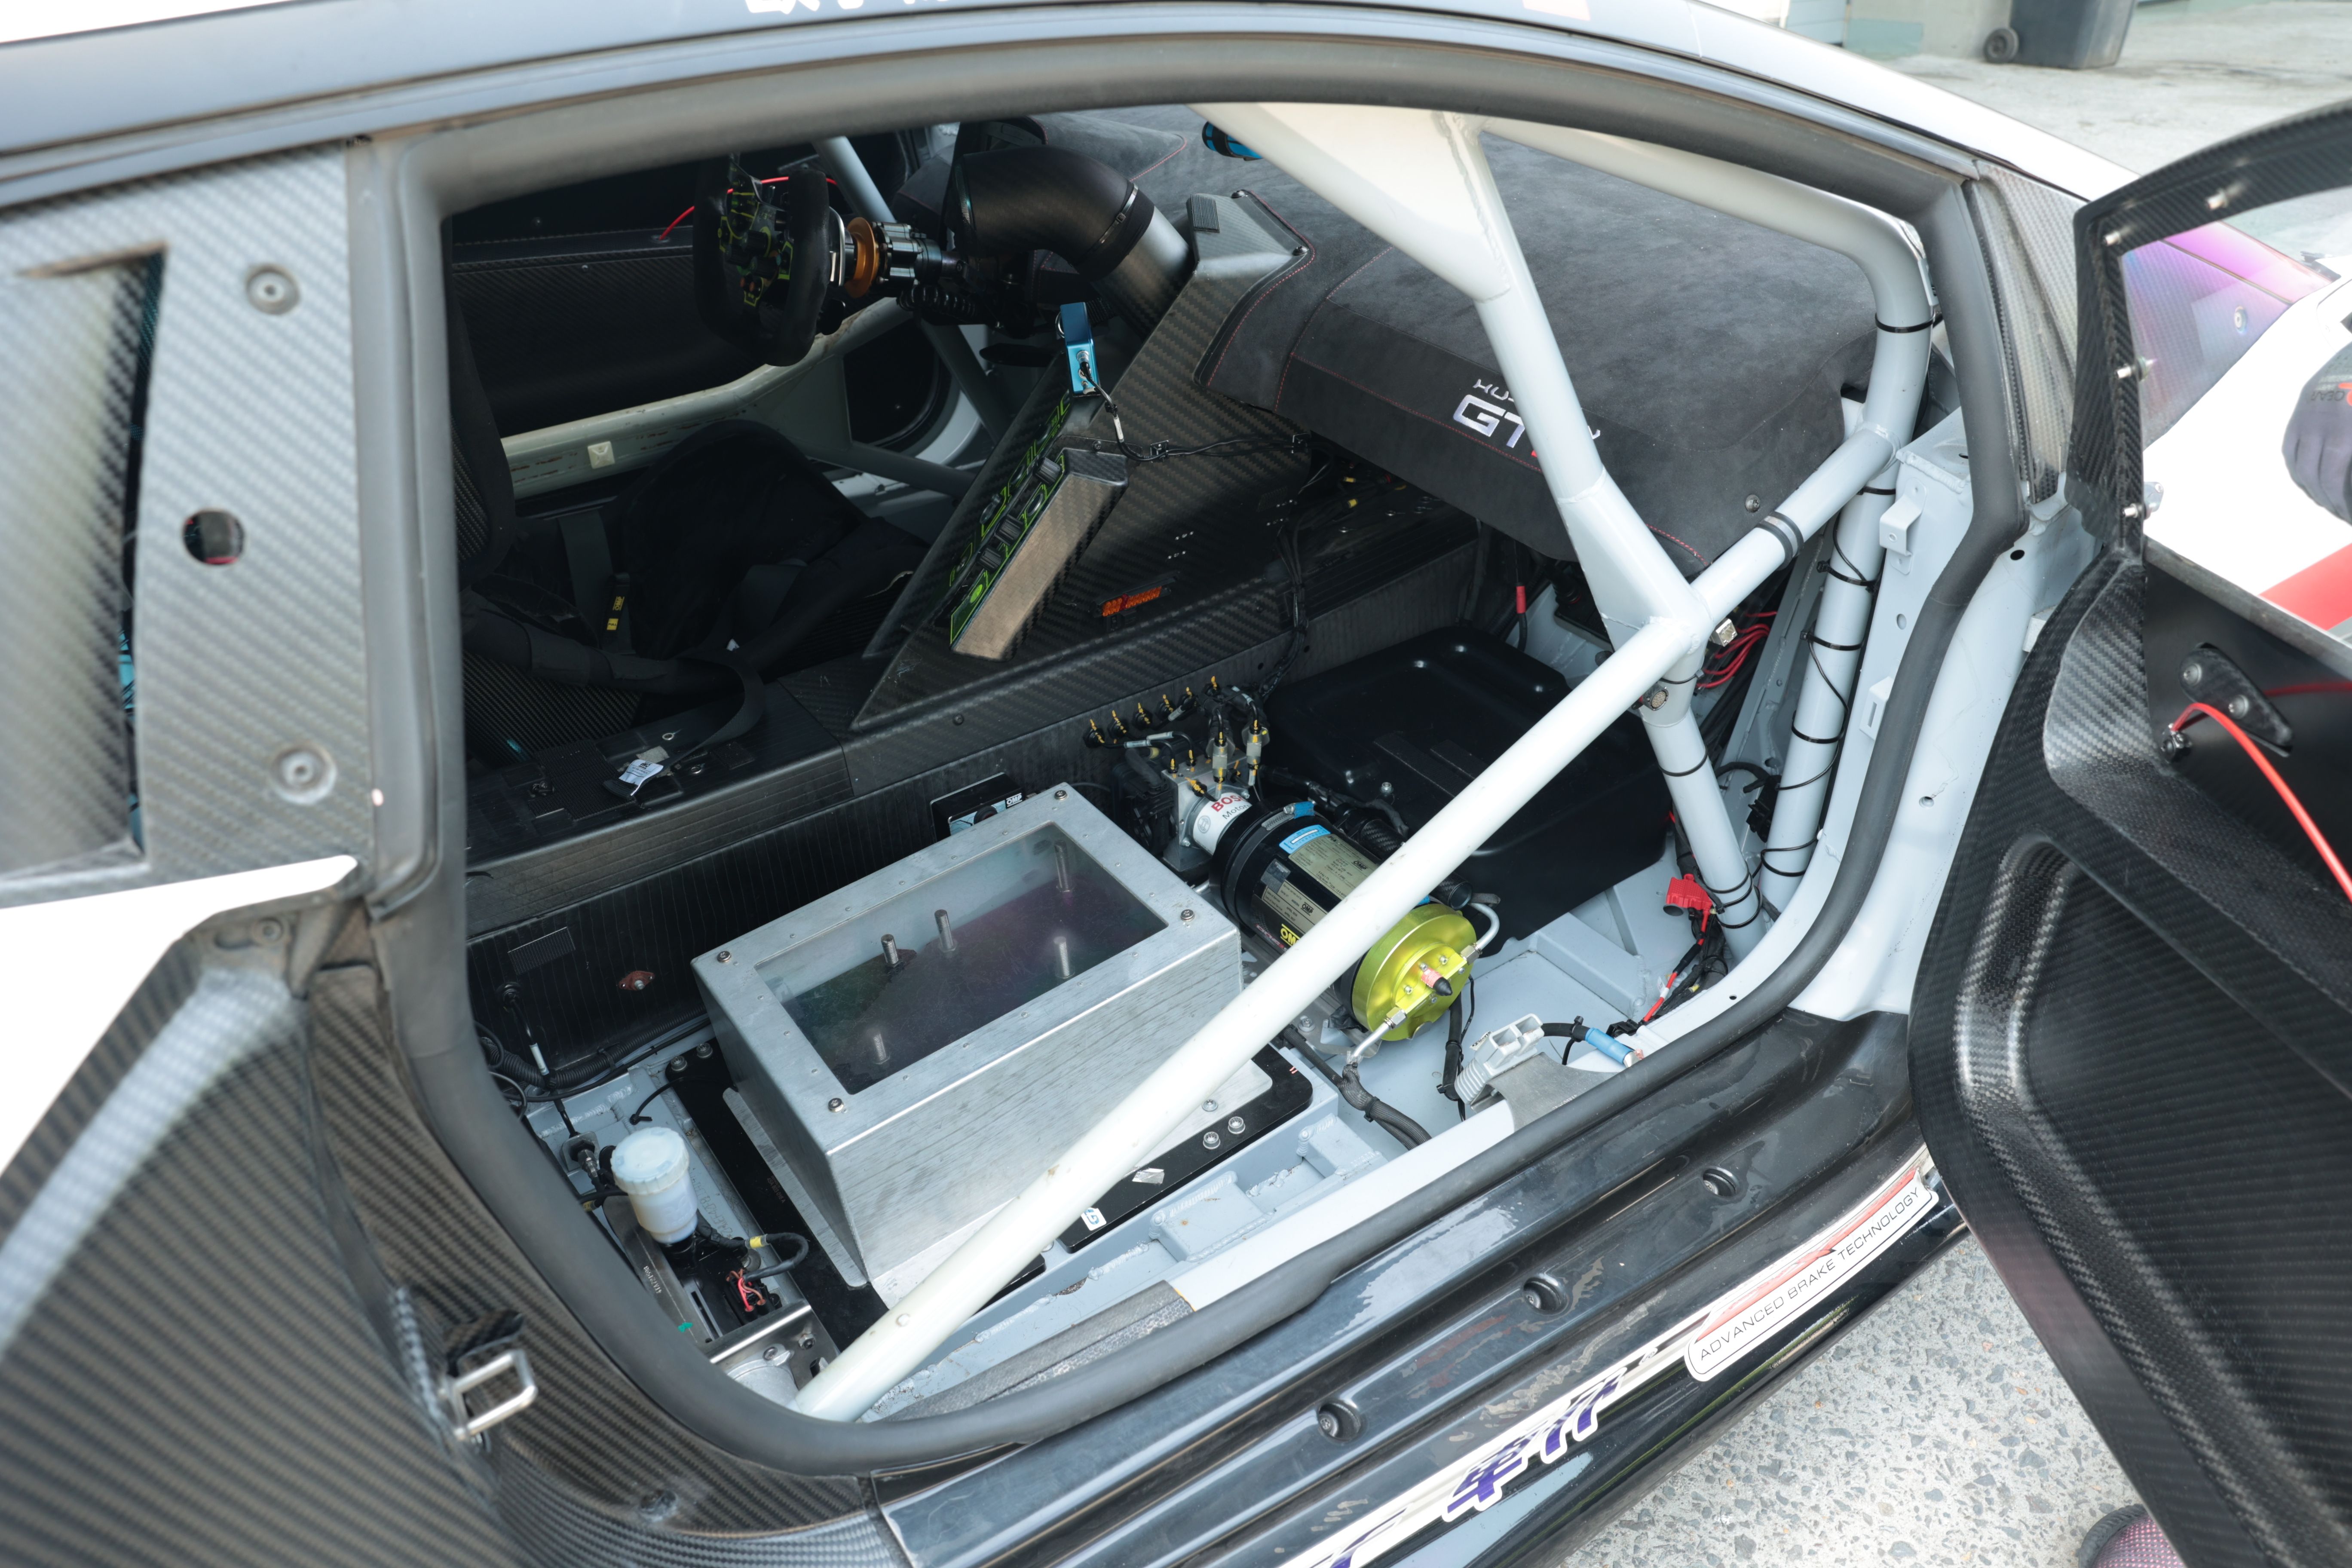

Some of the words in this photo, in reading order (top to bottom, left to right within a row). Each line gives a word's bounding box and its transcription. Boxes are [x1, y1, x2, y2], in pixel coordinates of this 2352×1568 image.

[613, 596, 625, 611] OMP
[1006, 793, 1022, 807] OMP
[1354, 860, 1368, 870] OMP
[1301, 903, 1314, 914] OMP
[1280, 923, 1299, 946] OM
[1700, 1296, 1785, 1361] ADVANCED
[1788, 1258, 1835, 1299] BRAKE
[1838, 1186, 1919, 1260] TECHNOLOGY
